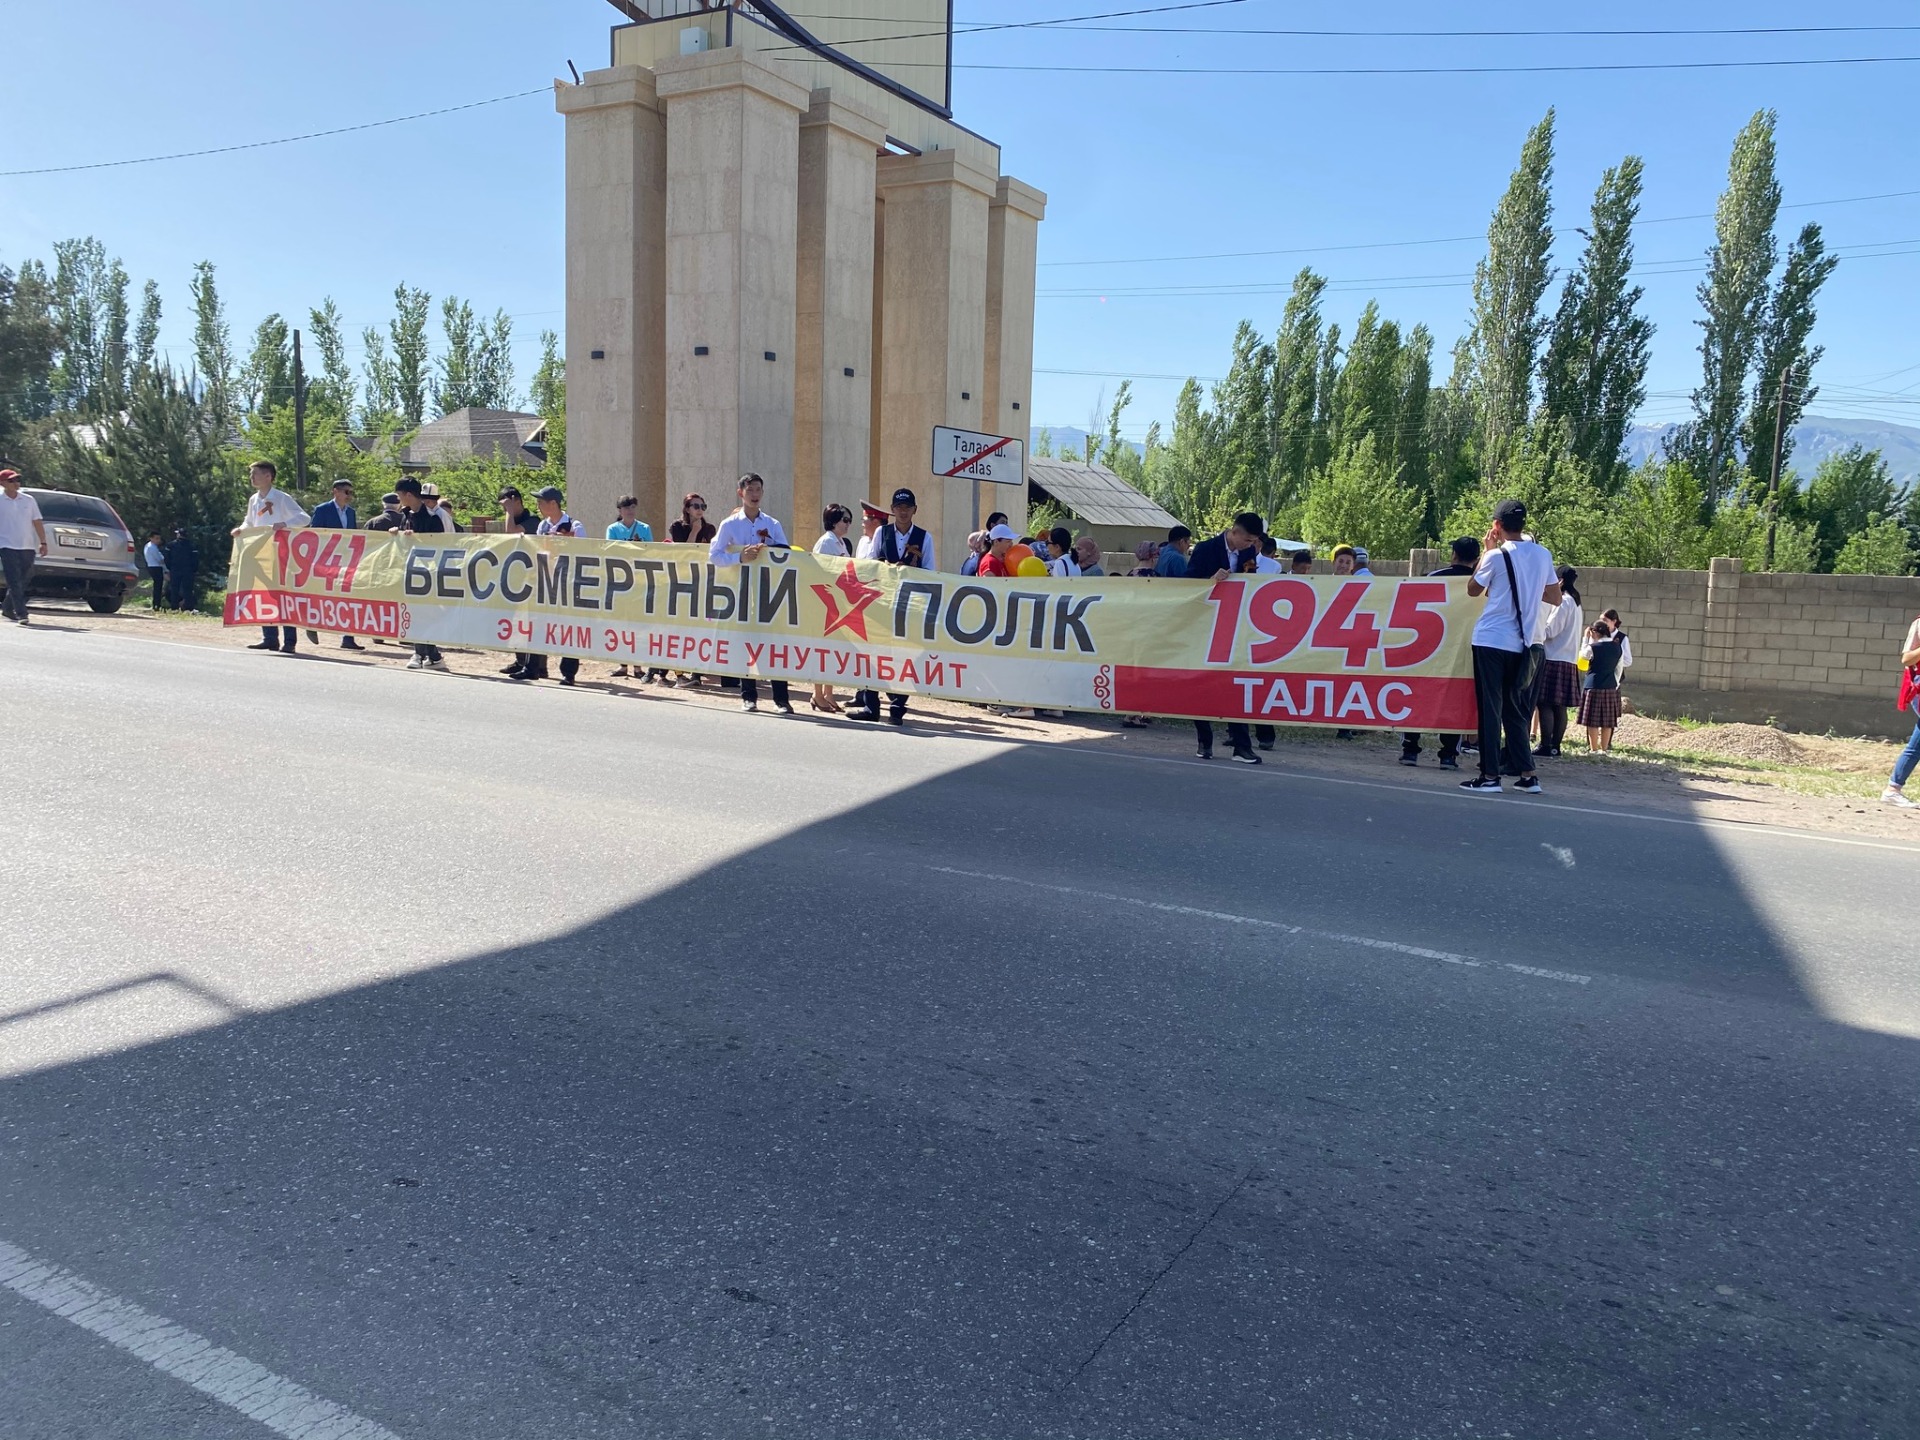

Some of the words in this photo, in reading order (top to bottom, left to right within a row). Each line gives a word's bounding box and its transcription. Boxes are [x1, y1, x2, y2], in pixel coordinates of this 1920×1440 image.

[960, 456, 992, 475] Talas
[273, 529, 366, 593] 1941
[233, 593, 396, 634] КЫРГЫЗСТАН
[404, 548, 798, 626] БЕССМЕРТНЫЙ
[894, 581, 1102, 653] ПОЛК
[1206, 579, 1447, 668] 1945
[497, 618, 533, 642] ЭЧ
[545, 622, 592, 649] КИМ
[604, 628, 635, 653] ЭЧ
[649, 633, 729, 664] НЕРСЕ
[744, 642, 967, 689] УНУТУЛБАЙТ
[1233, 677, 1413, 721] ТАЛАС
